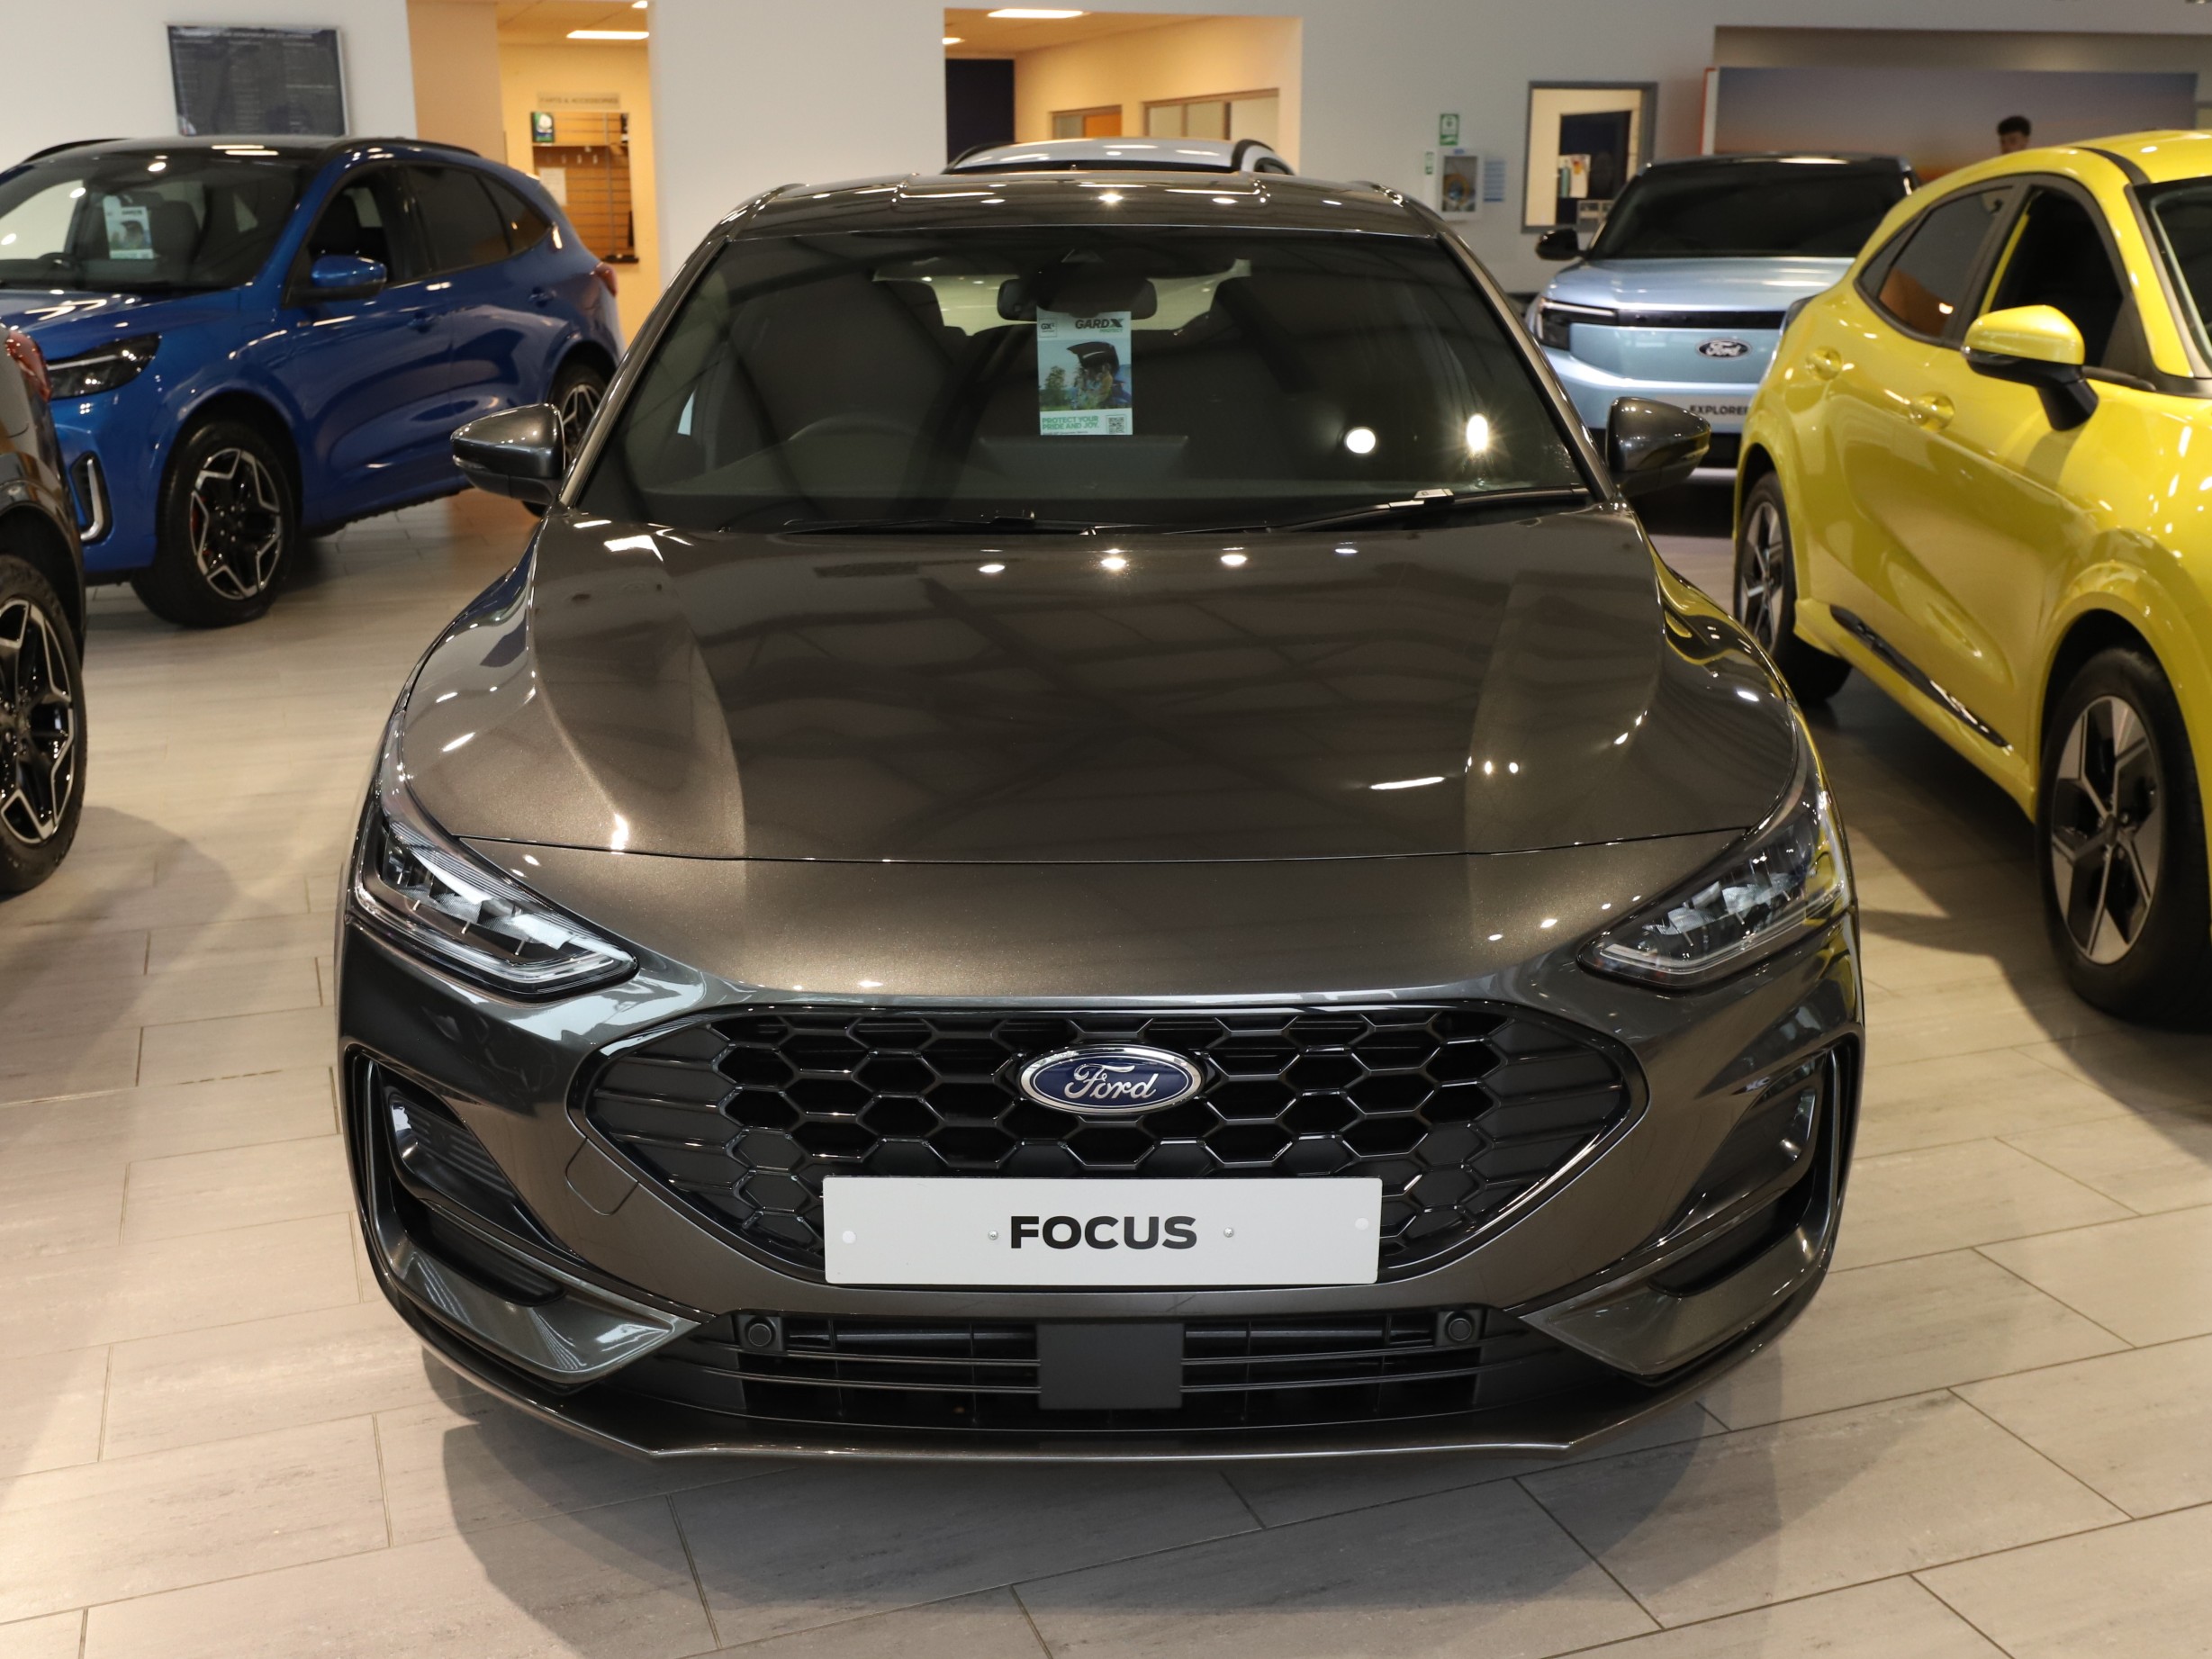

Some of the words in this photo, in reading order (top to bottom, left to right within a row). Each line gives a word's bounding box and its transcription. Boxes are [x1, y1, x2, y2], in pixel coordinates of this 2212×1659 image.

[1075, 319, 1124, 329] GARDX
[1706, 340, 1742, 356] Ford
[1064, 1063, 1159, 1099] Ford
[1010, 1215, 1197, 1250] FOCUS
